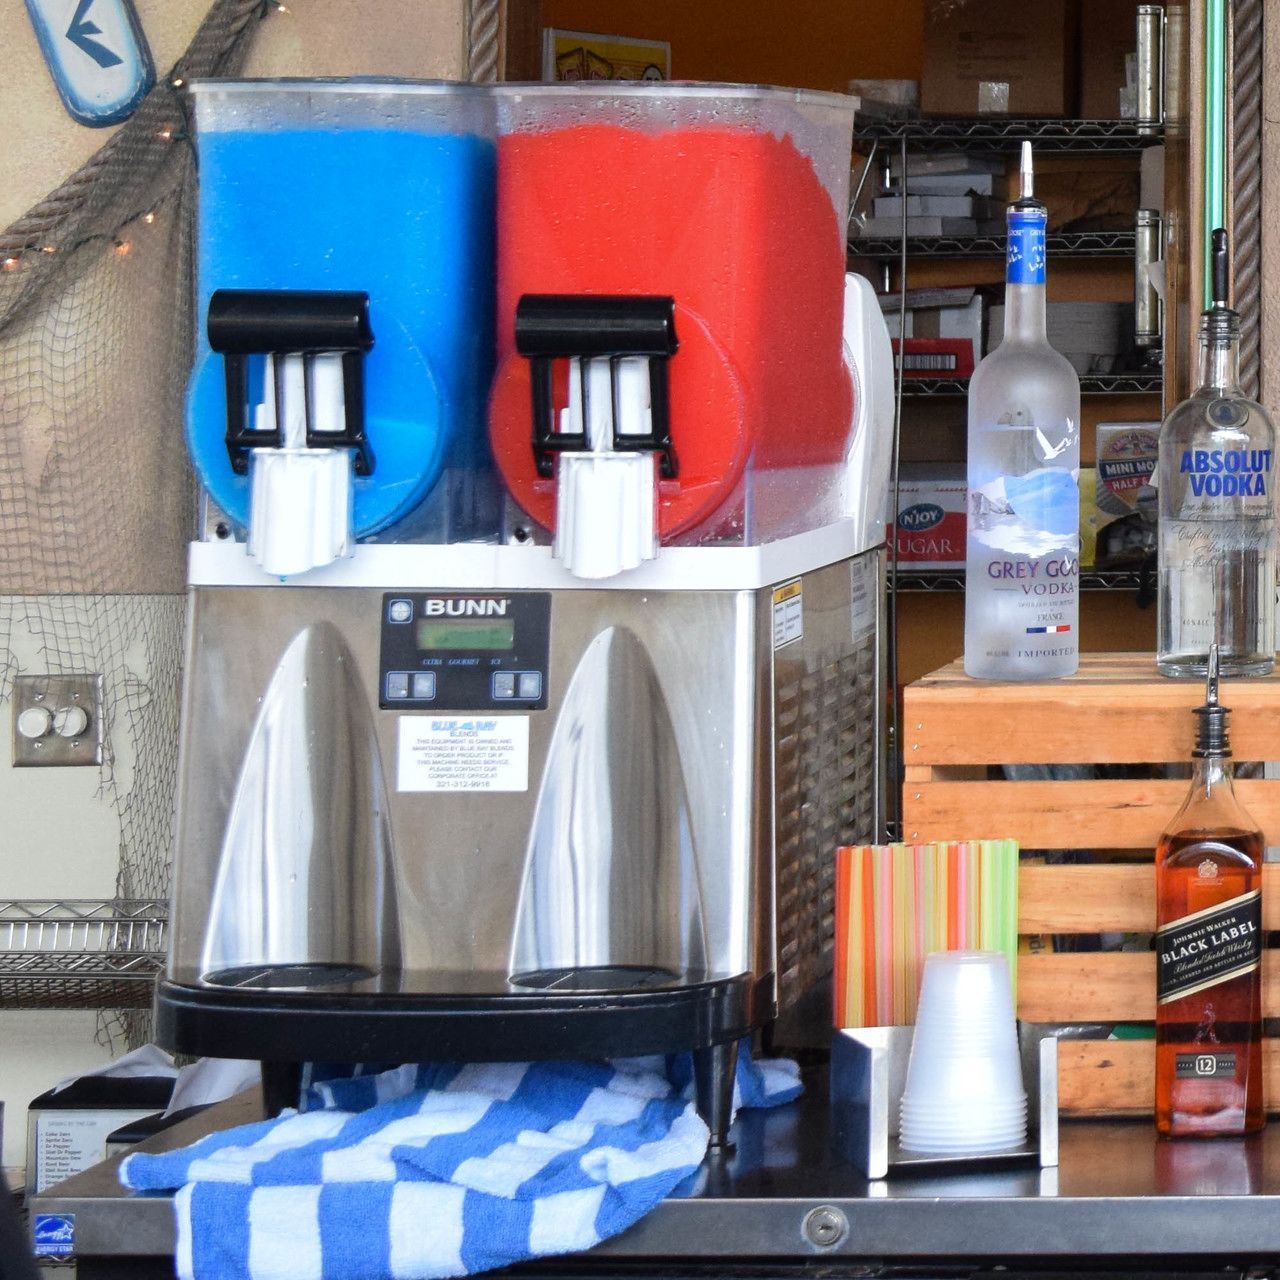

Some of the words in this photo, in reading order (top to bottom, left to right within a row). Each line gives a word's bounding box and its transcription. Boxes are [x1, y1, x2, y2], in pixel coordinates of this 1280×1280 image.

[1105, 461, 1134, 477] MINI
[1180, 449, 1273, 474] ABSOLUT
[1111, 479, 1142, 492] HALF
[1189, 473, 1267, 498] VODKA
[886, 538, 953, 554] SUGAR
[987, 561, 1040, 579] GREY
[1021, 582, 1075, 596] VODKA
[425, 599, 508, 616] BUNN
[1017, 647, 1076, 658] IMPORTED
[432, 720, 458, 731] BLUE
[1161, 938, 1208, 965] BLACK
[1211, 920, 1257, 947] LABEL
[1199, 1059, 1212, 1071] 12
